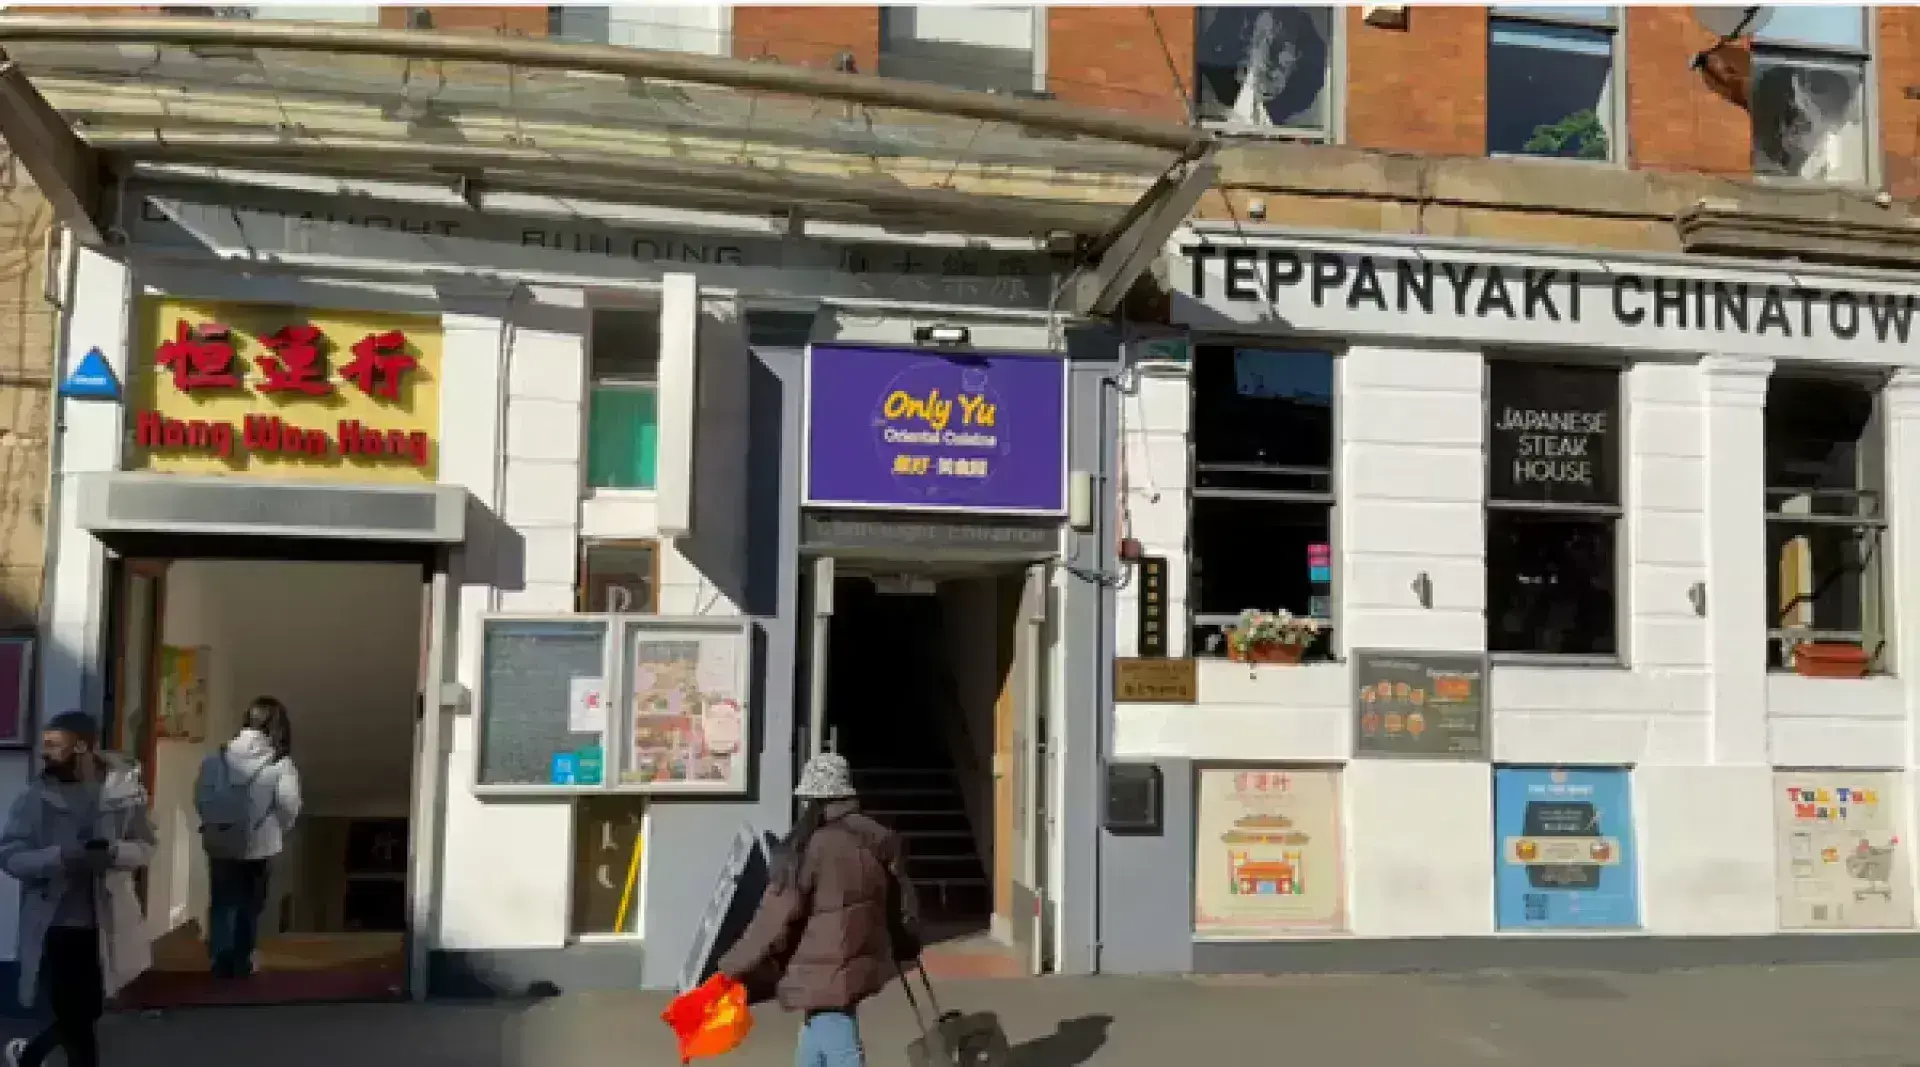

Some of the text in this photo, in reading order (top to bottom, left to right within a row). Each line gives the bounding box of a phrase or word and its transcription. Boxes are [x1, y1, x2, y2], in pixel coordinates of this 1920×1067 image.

[1180, 243, 1581, 324] TEPPANYAKI
[885, 388, 997, 430] Only Yu
[1496, 407, 1608, 433] JAPANESE
[1518, 435, 1588, 456] STEAK
[1512, 460, 1592, 484] HOUSE
